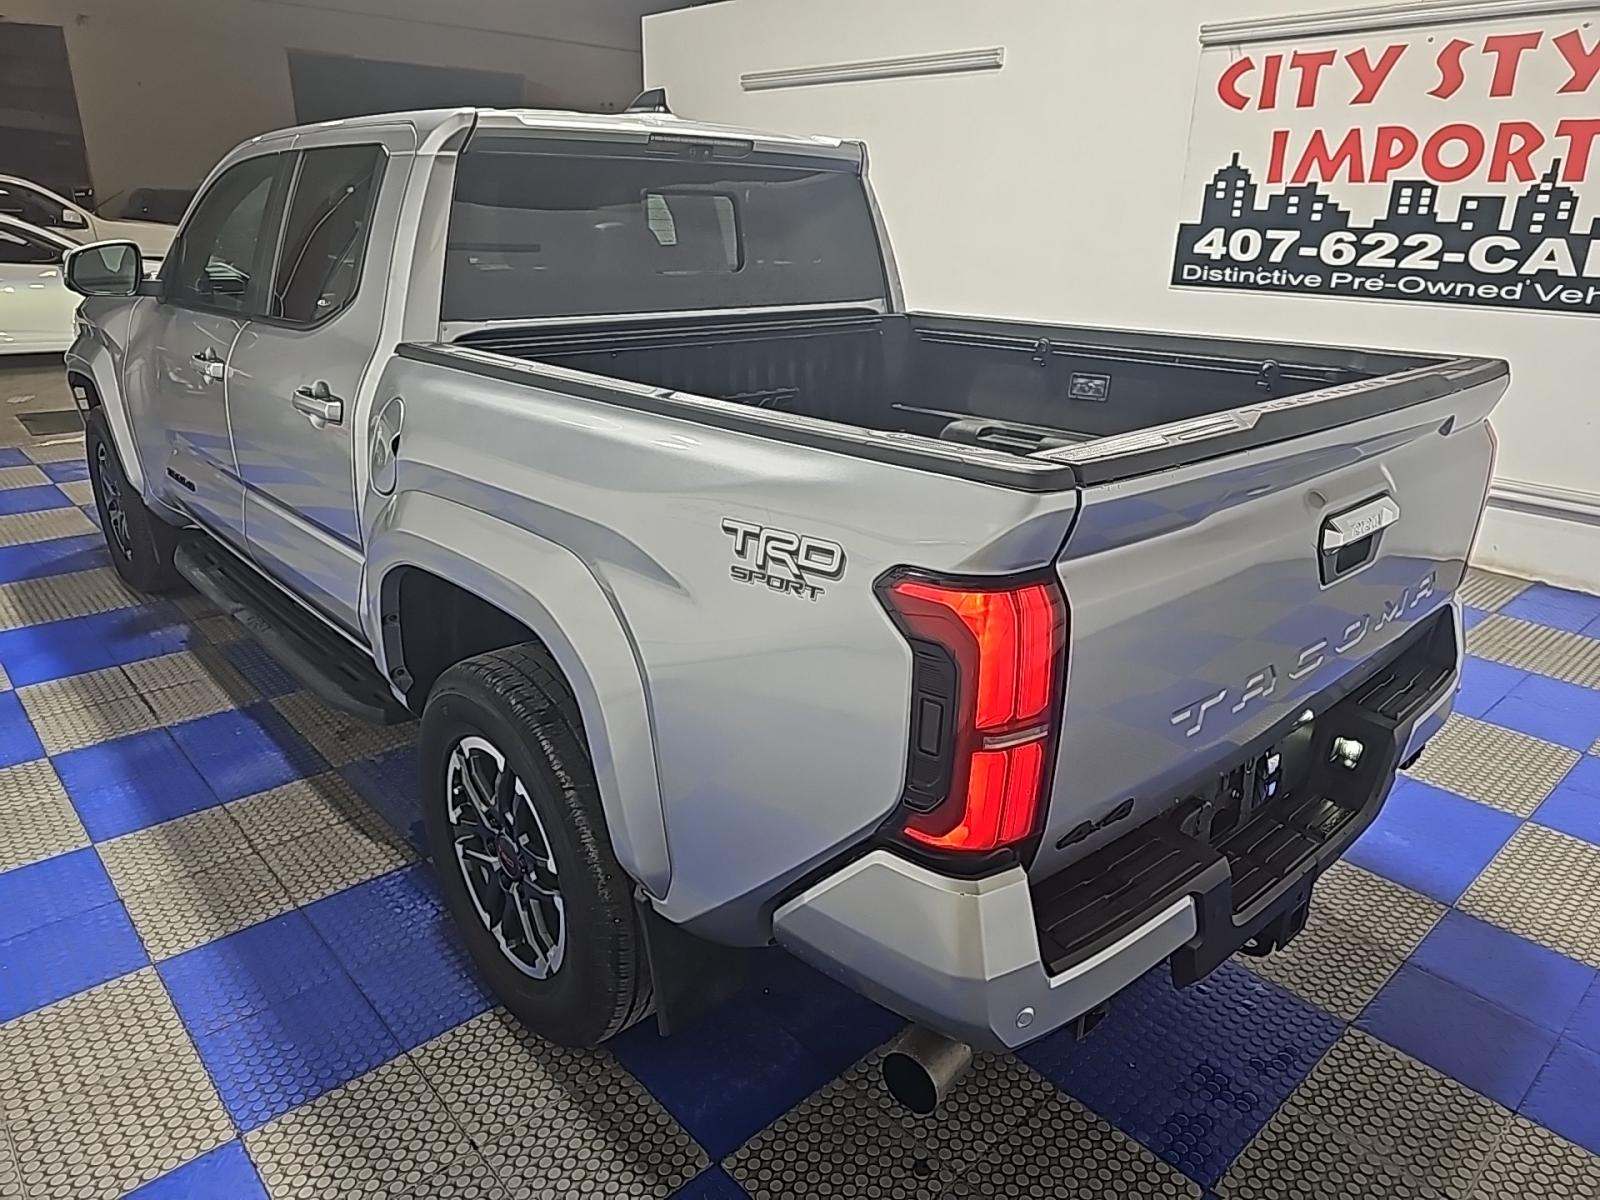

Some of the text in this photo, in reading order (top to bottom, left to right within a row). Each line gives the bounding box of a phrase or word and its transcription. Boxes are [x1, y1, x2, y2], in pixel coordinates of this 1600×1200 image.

[1217, 28, 1600, 111] CITY STY
[1266, 118, 1600, 184] IMPORT
[1182, 264, 1322, 288] Distinctive
[1330, 272, 1524, 300] Pre-Owned
[721, 517, 847, 582] TRD
[730, 565, 825, 602] SPORT
